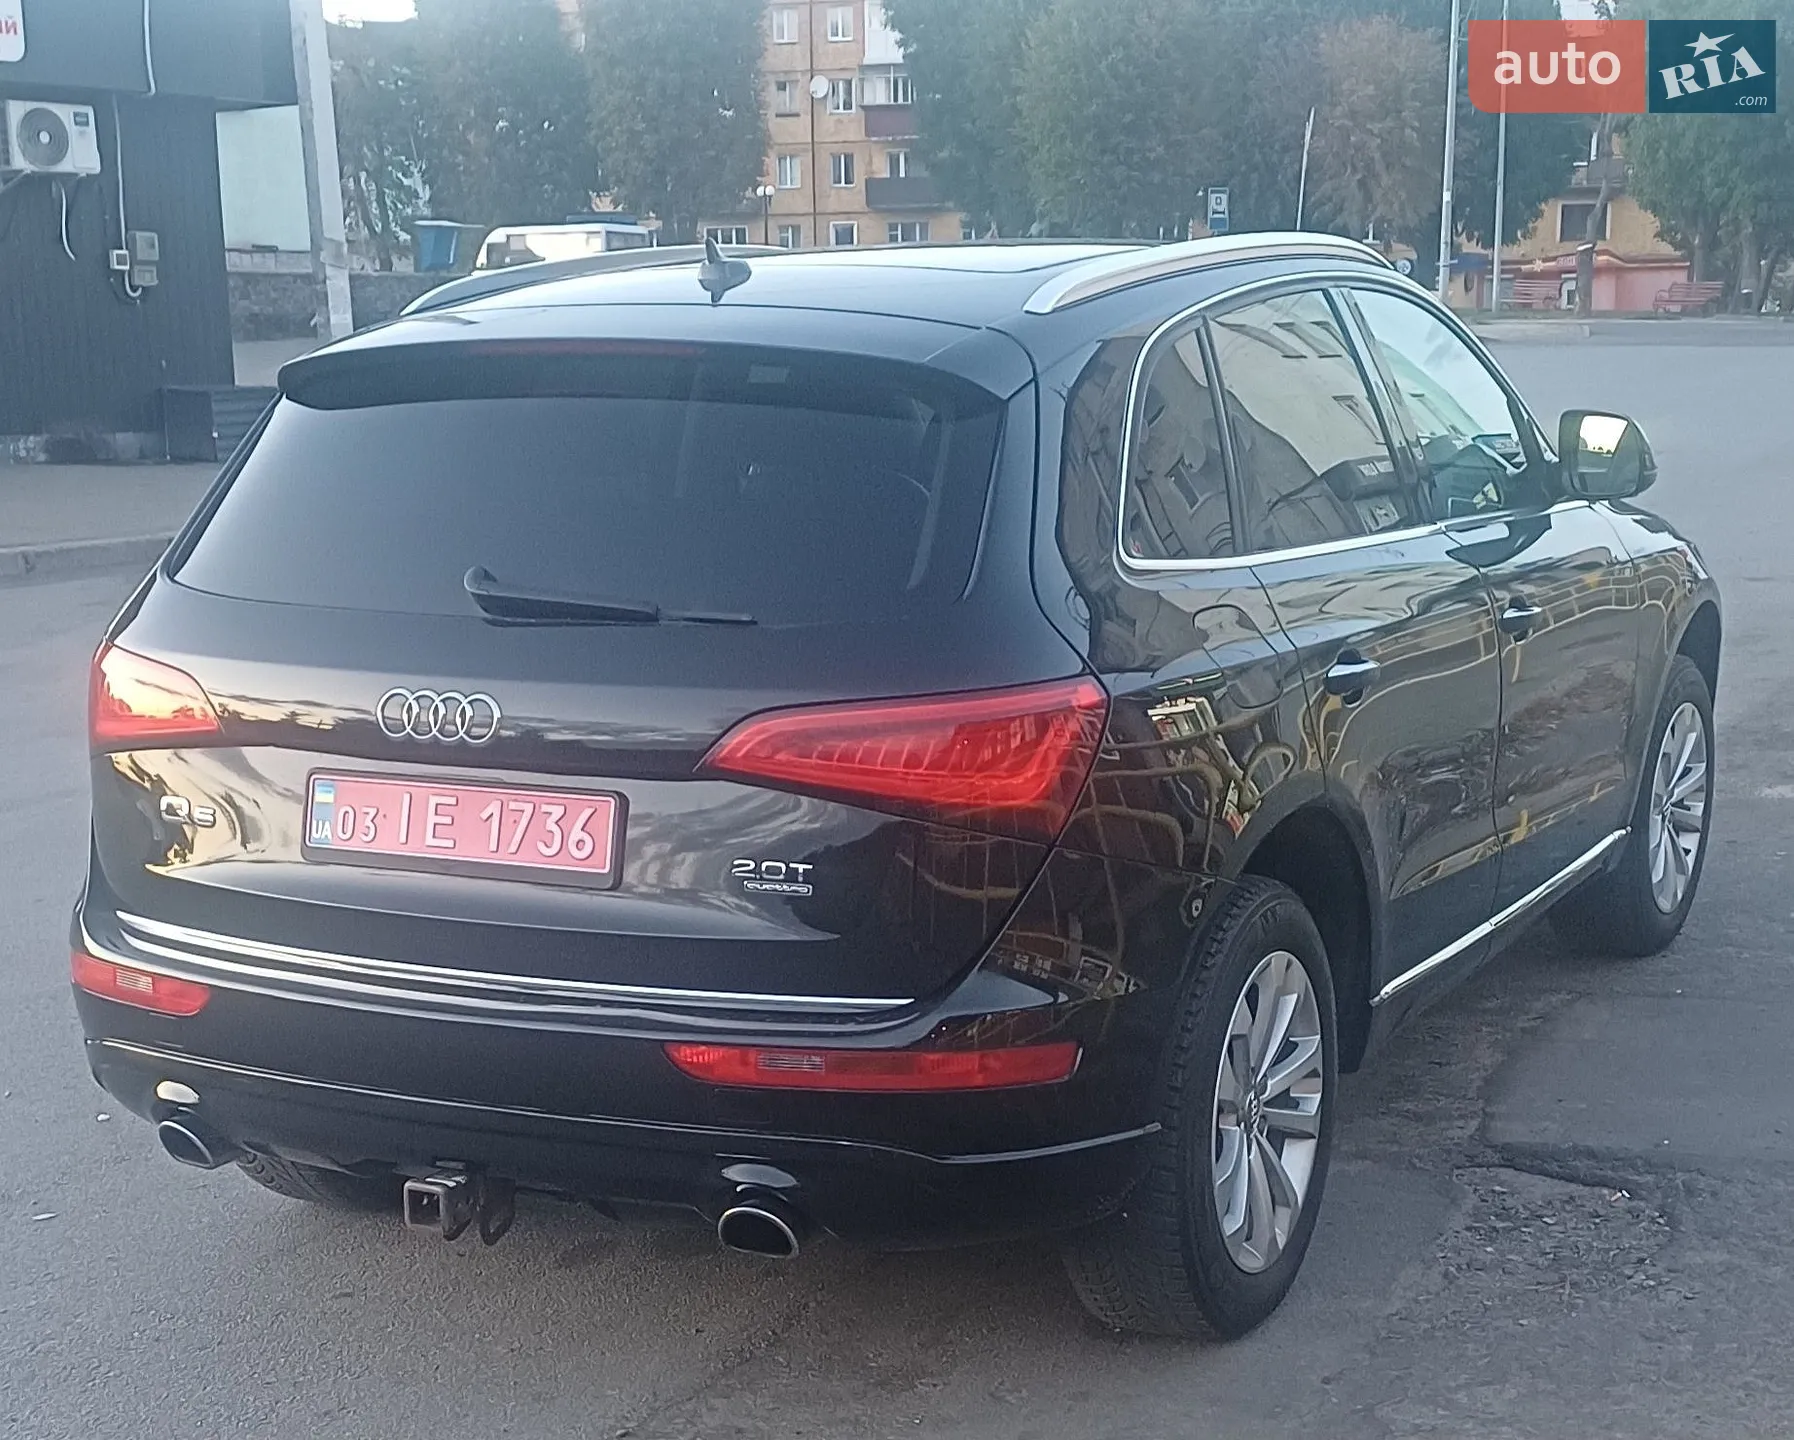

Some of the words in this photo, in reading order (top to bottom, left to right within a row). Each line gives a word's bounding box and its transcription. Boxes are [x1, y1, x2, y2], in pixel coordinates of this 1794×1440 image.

[312, 819, 332, 840] UA
[336, 805, 379, 844] 03
[399, 792, 458, 849] IE
[479, 799, 597, 860] 1736
[731, 859, 813, 882] 2.0T
